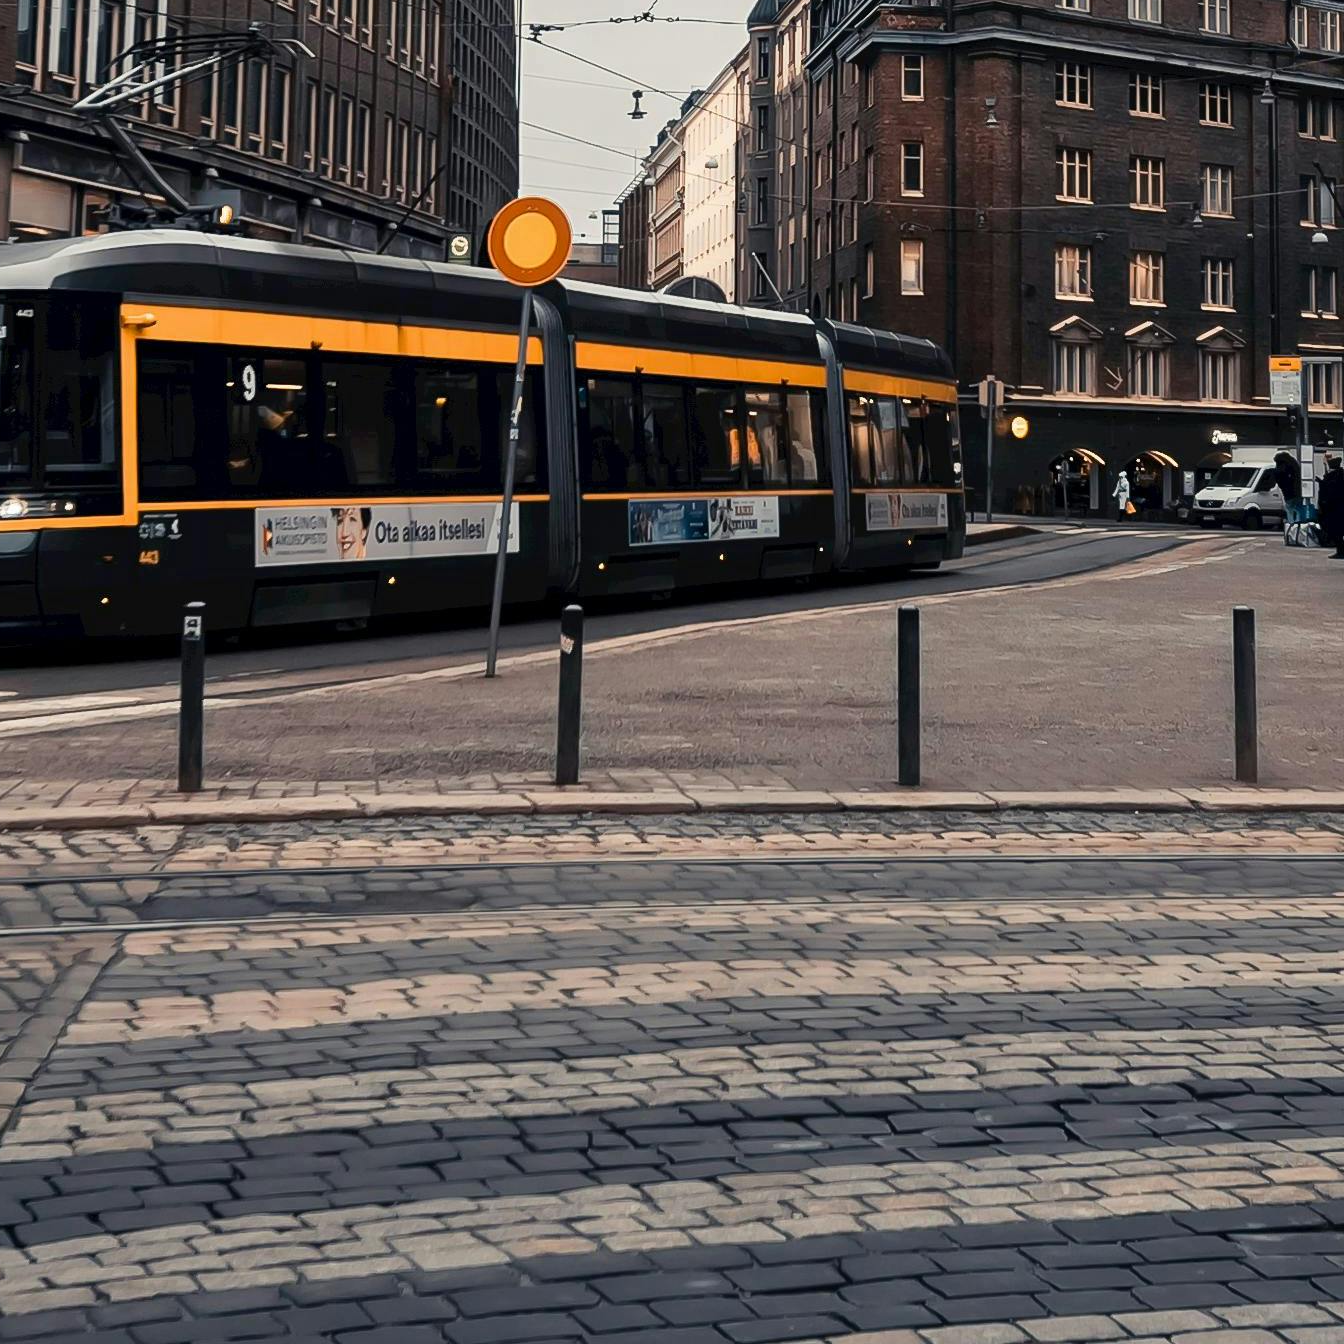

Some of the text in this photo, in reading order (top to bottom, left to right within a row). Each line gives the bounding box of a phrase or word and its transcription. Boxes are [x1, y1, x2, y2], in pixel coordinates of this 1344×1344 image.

[242, 364, 256, 402] 9
[375, 520, 399, 544] Ota
[402, 520, 436, 542] aikaa
[438, 517, 485, 541] itsellesi
